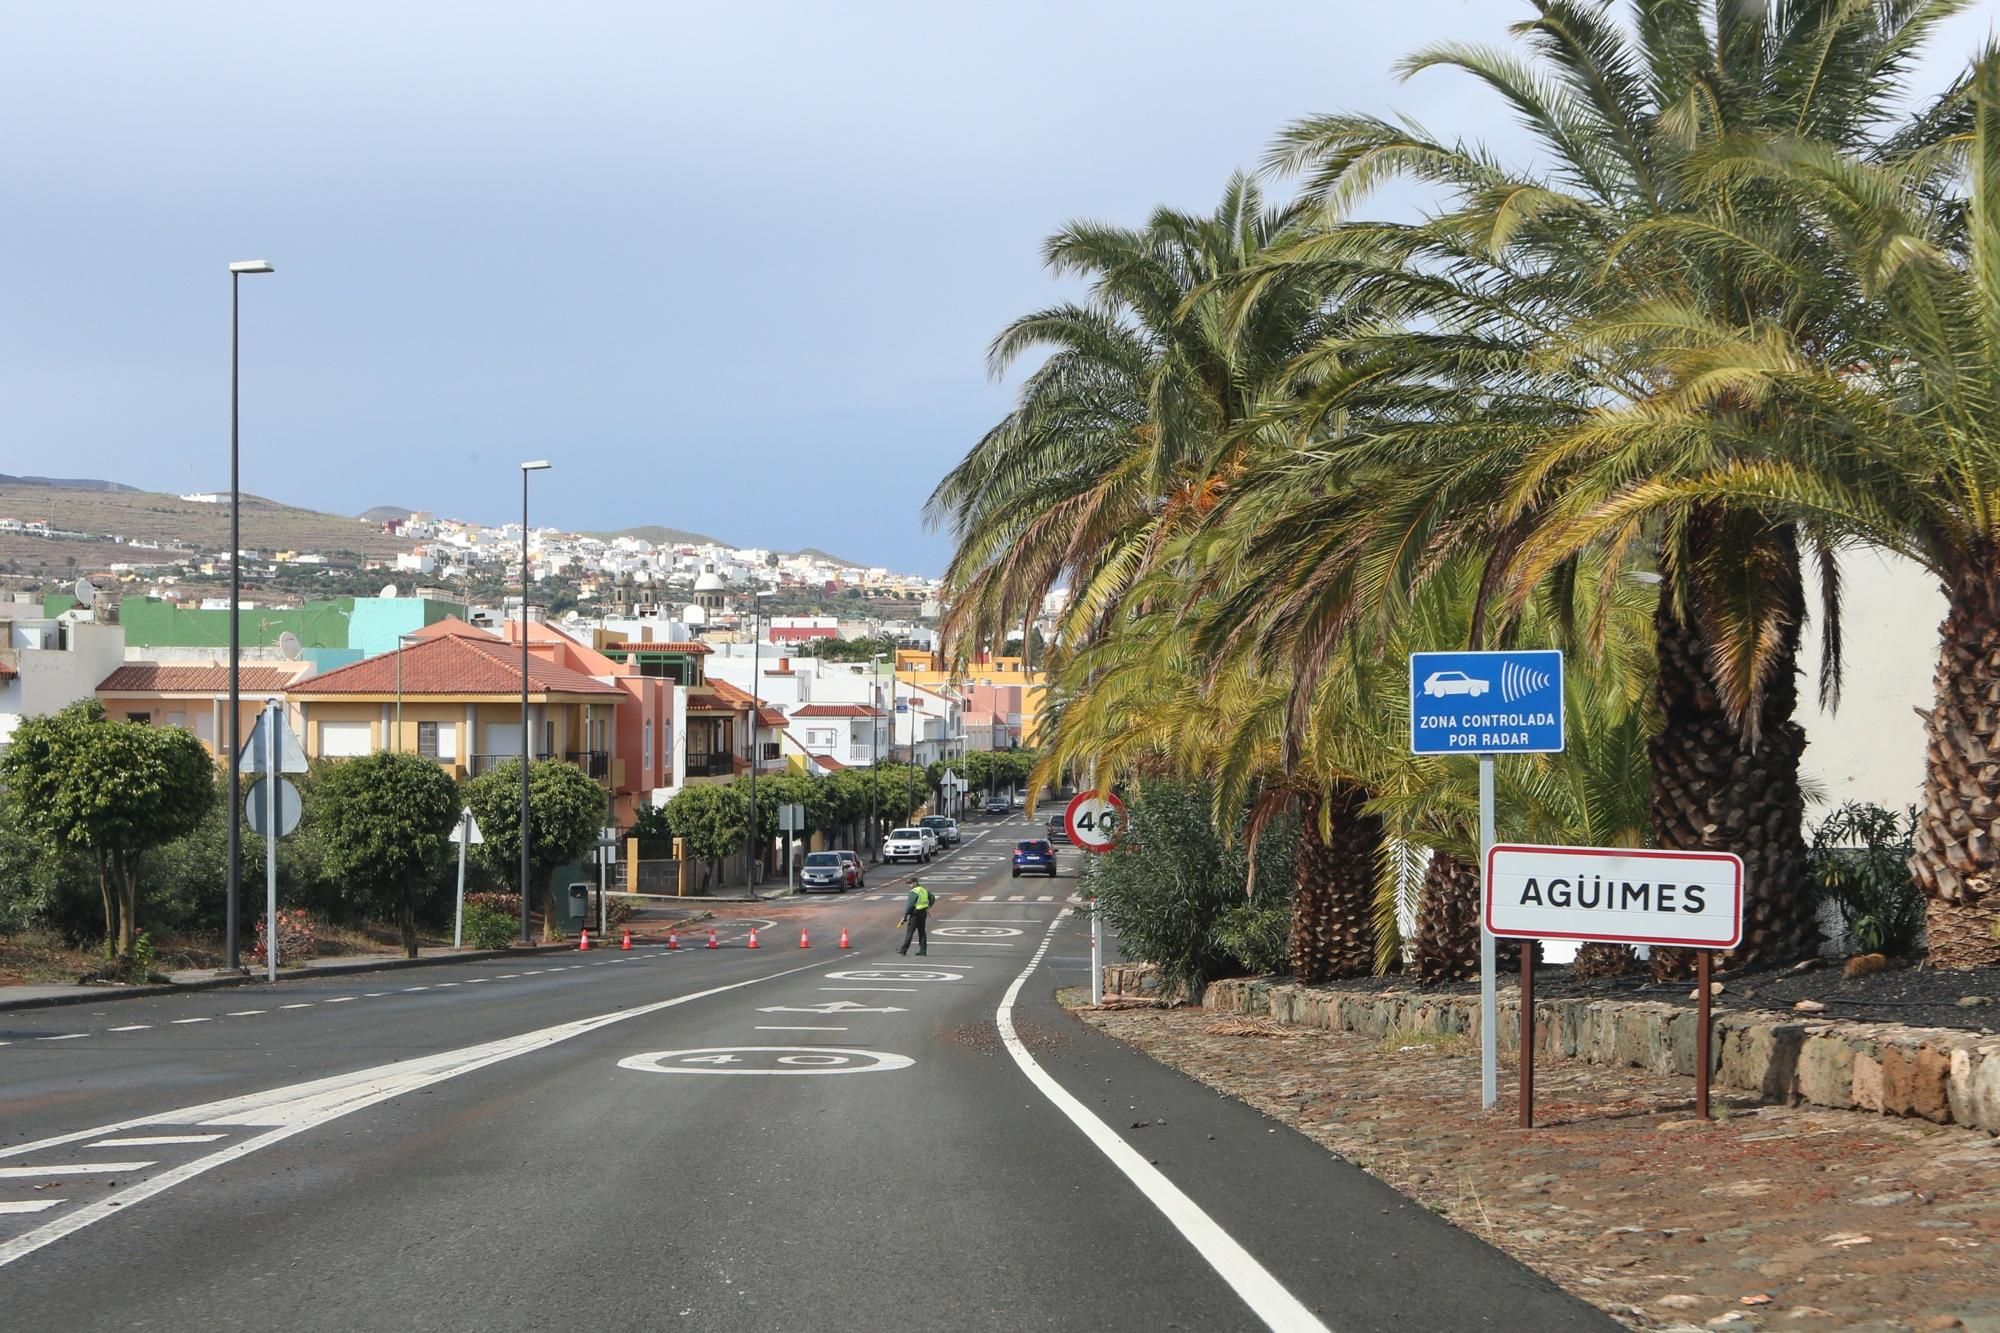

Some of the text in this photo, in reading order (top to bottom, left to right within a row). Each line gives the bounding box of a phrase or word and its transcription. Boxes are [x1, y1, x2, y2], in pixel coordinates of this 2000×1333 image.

[1420, 713, 1555, 729] ZONA CONTROLADA
[1449, 732, 1529, 747] POR RADAR
[1076, 811, 1114, 832] 40
[1519, 874, 1706, 914] AGÜIMES
[680, 1054, 850, 1065] 40
